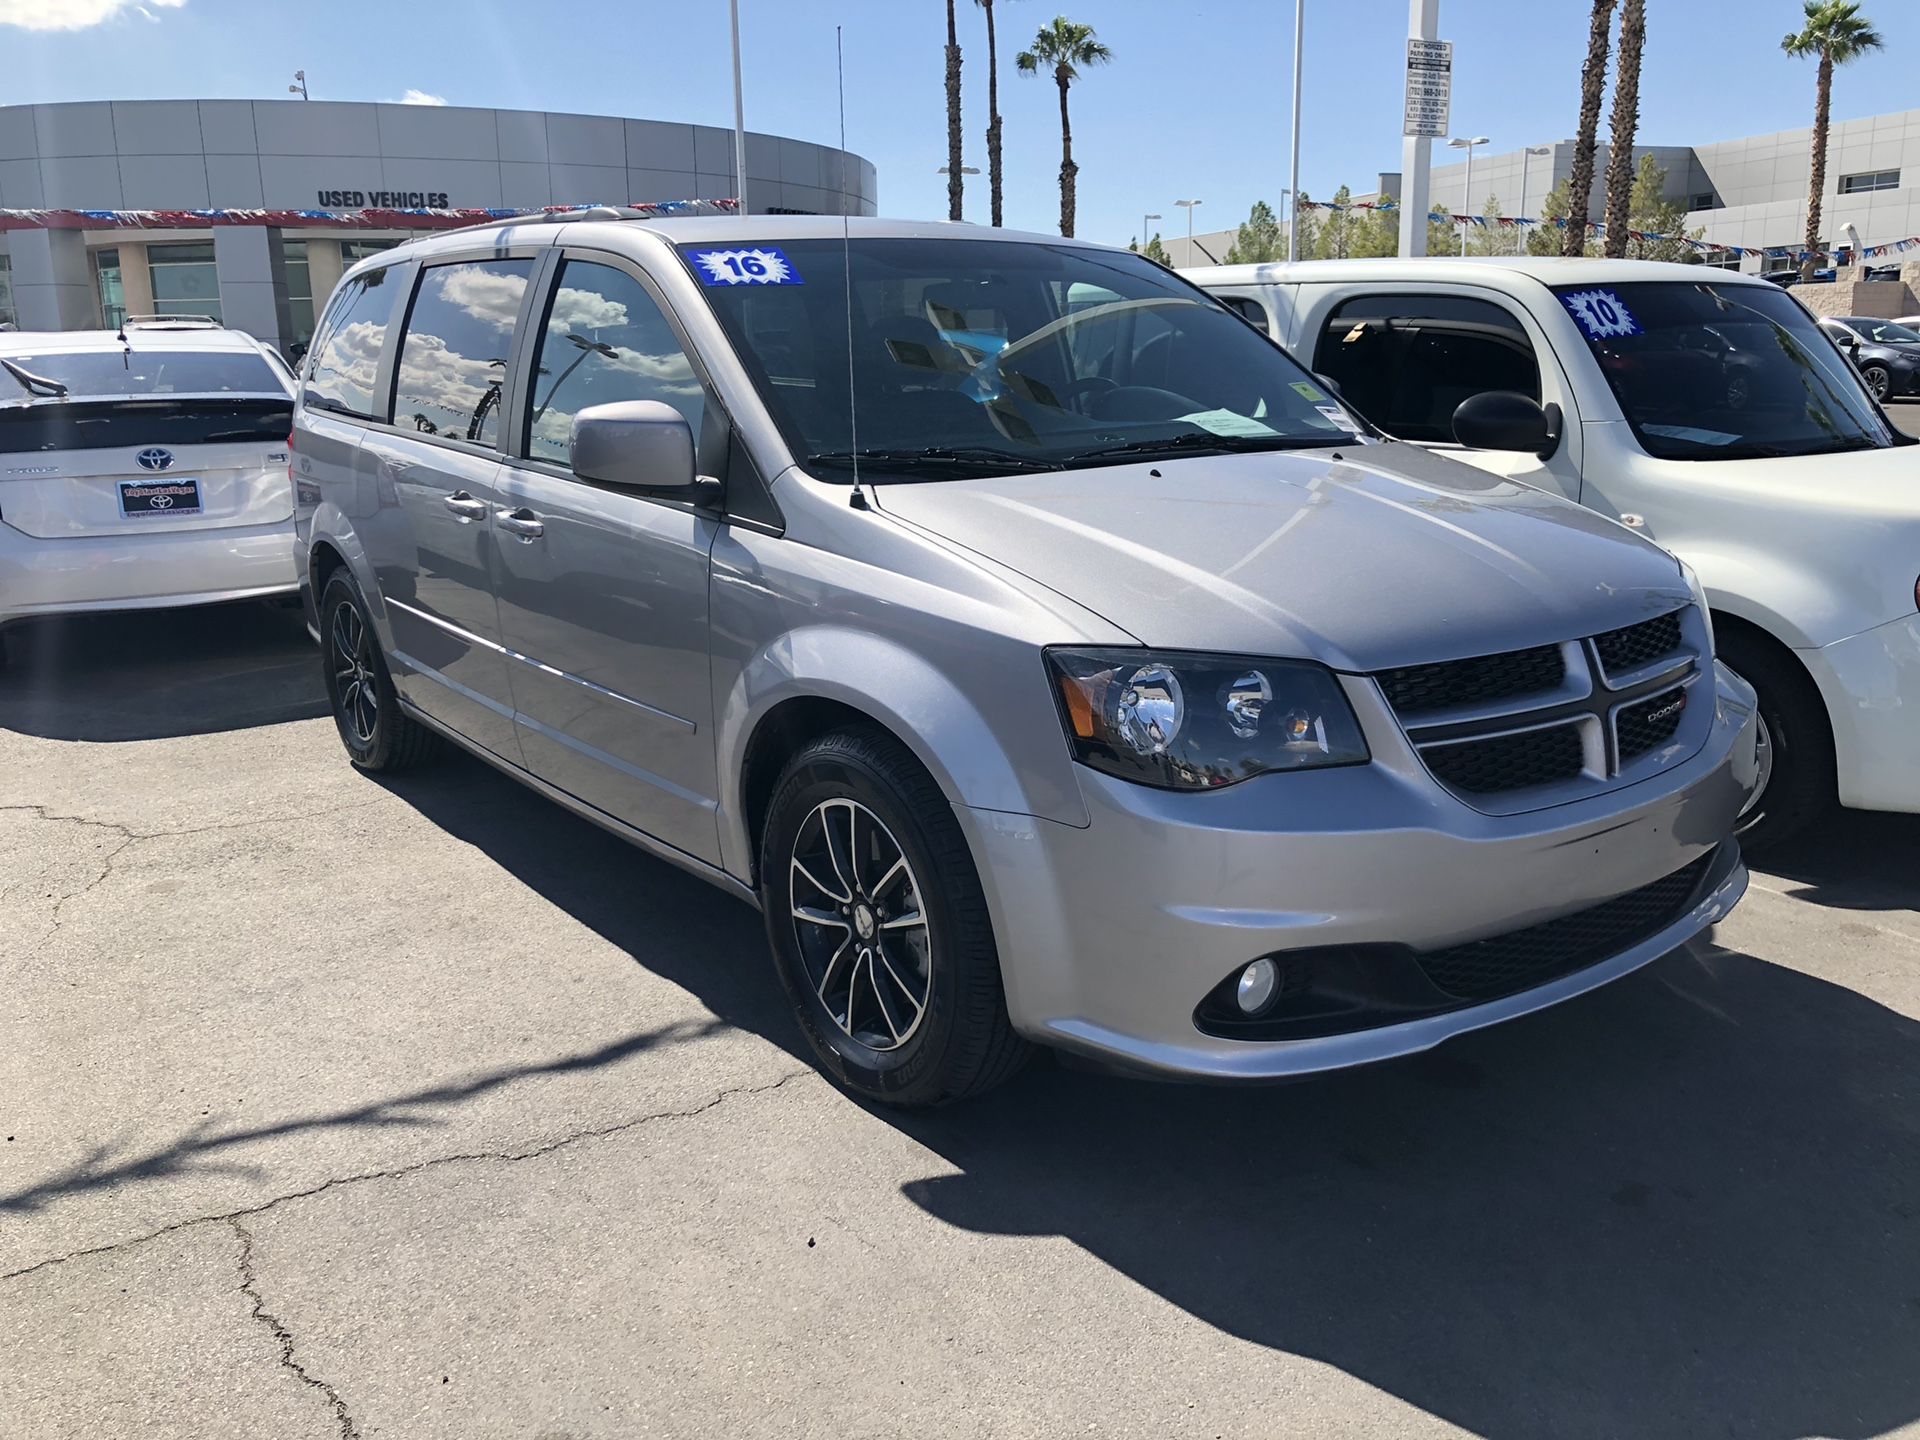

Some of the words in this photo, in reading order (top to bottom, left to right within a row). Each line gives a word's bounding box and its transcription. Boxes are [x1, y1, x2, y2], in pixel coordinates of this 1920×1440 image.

[1410, 50, 1433, 58] PARKING
[1413, 43, 1447, 51] AUTHORIZED
[318, 190, 364, 207] USED
[368, 191, 449, 209] VEHICLES
[723, 257, 766, 276] 16
[1585, 298, 1619, 327] 10
[1647, 700, 1681, 721] DODGE
